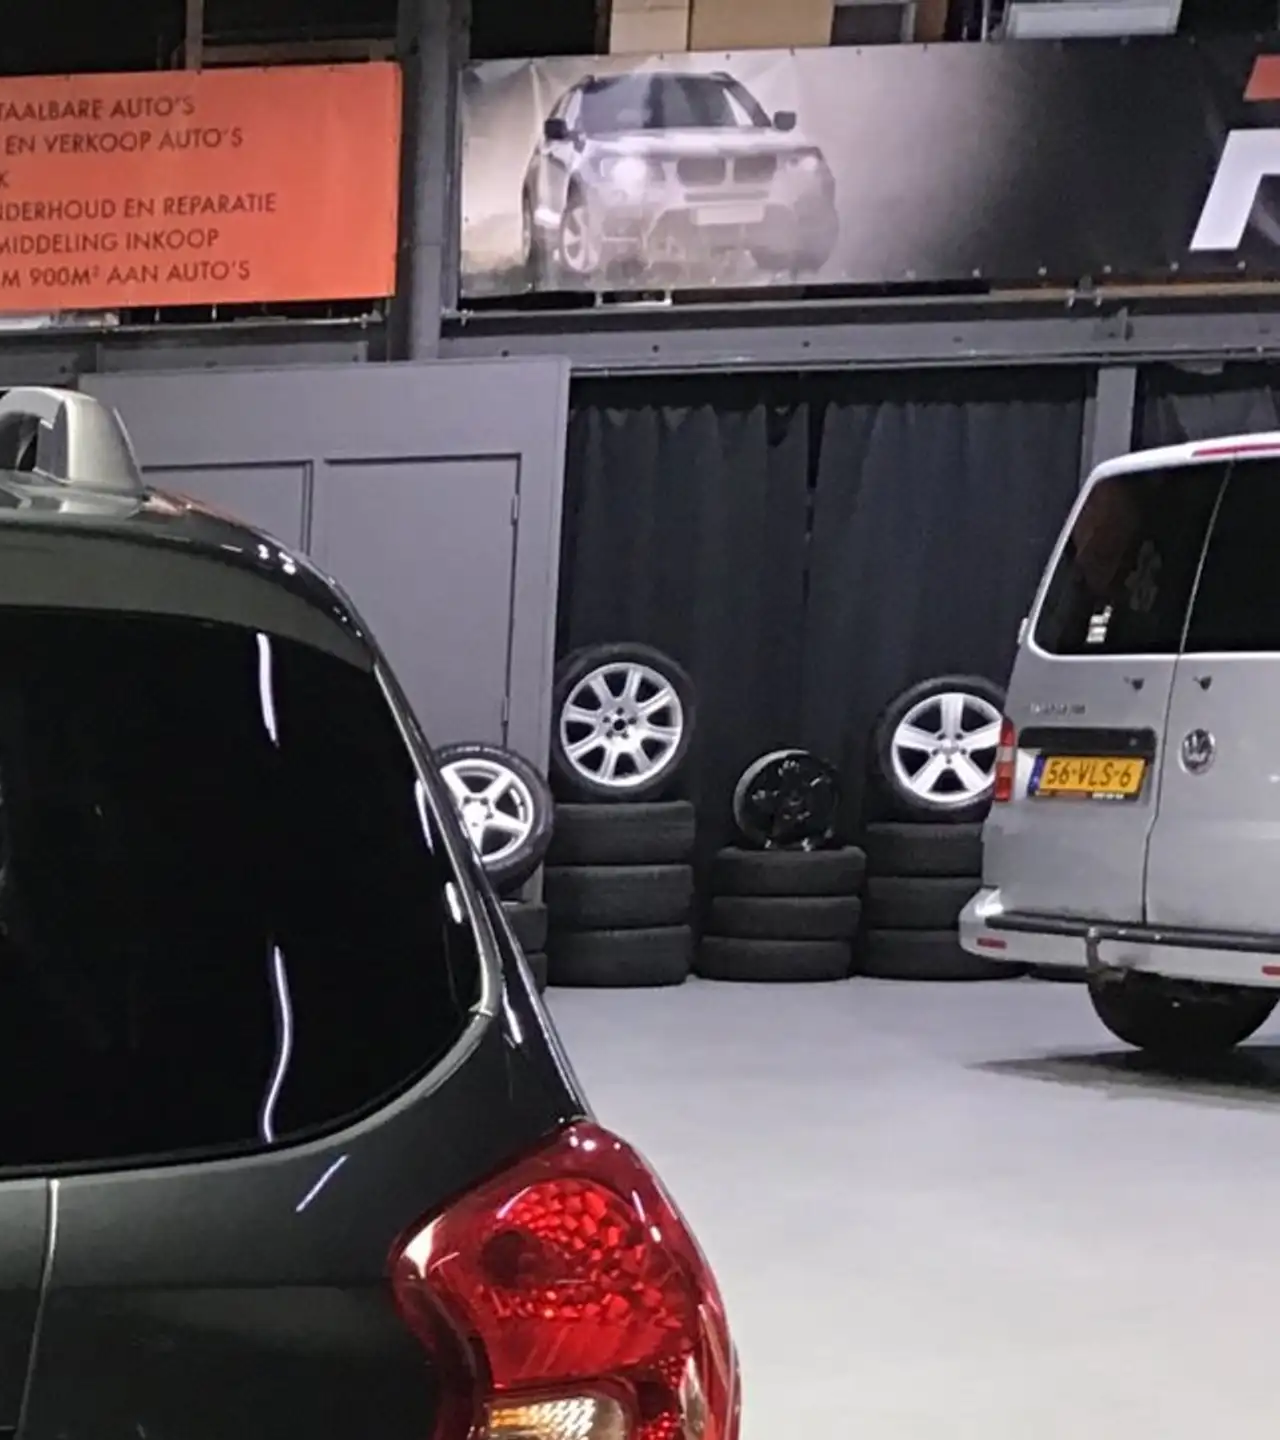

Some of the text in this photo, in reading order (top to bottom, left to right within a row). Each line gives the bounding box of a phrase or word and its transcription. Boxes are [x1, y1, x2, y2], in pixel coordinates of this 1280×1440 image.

[109, 95, 196, 120] AUTO'S
[4, 134, 36, 156] EN
[42, 131, 152, 154] VERKOOP
[158, 127, 244, 151] AUTO'S
[124, 197, 156, 219] EN
[163, 192, 277, 216] REPARATIE
[125, 228, 220, 252] INKOOP
[106, 264, 159, 285] AAN
[166, 261, 251, 282] AUTO'S
[1046, 759, 1133, 788] 56-VLS-6
